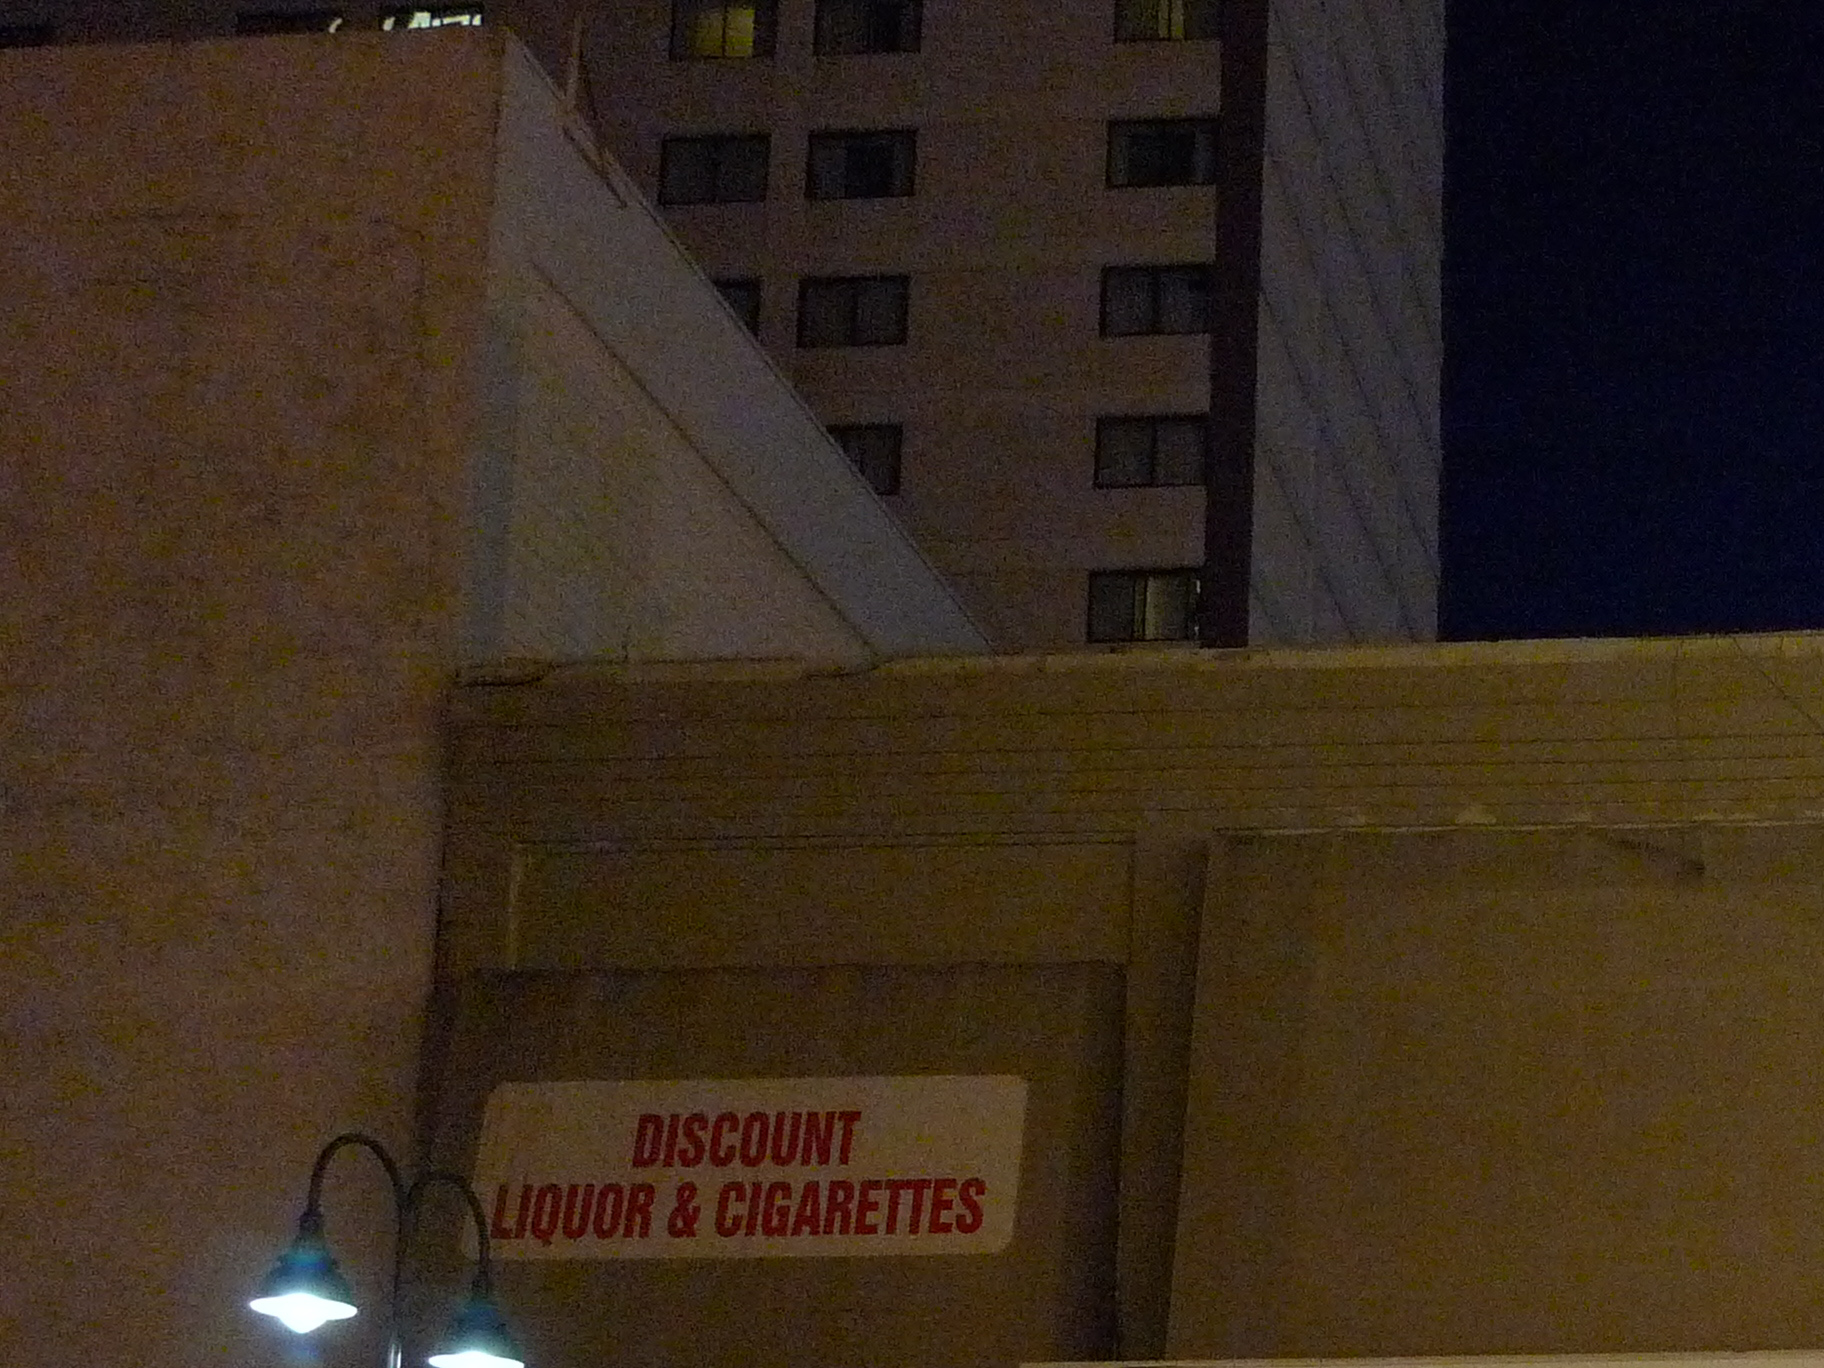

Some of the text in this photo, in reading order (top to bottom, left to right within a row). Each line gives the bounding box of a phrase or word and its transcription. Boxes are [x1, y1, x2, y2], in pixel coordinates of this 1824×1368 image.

[632, 1110, 862, 1168] DISCOUNT
[490, 1177, 987, 1242] LIQUOR & CIGARETTES
